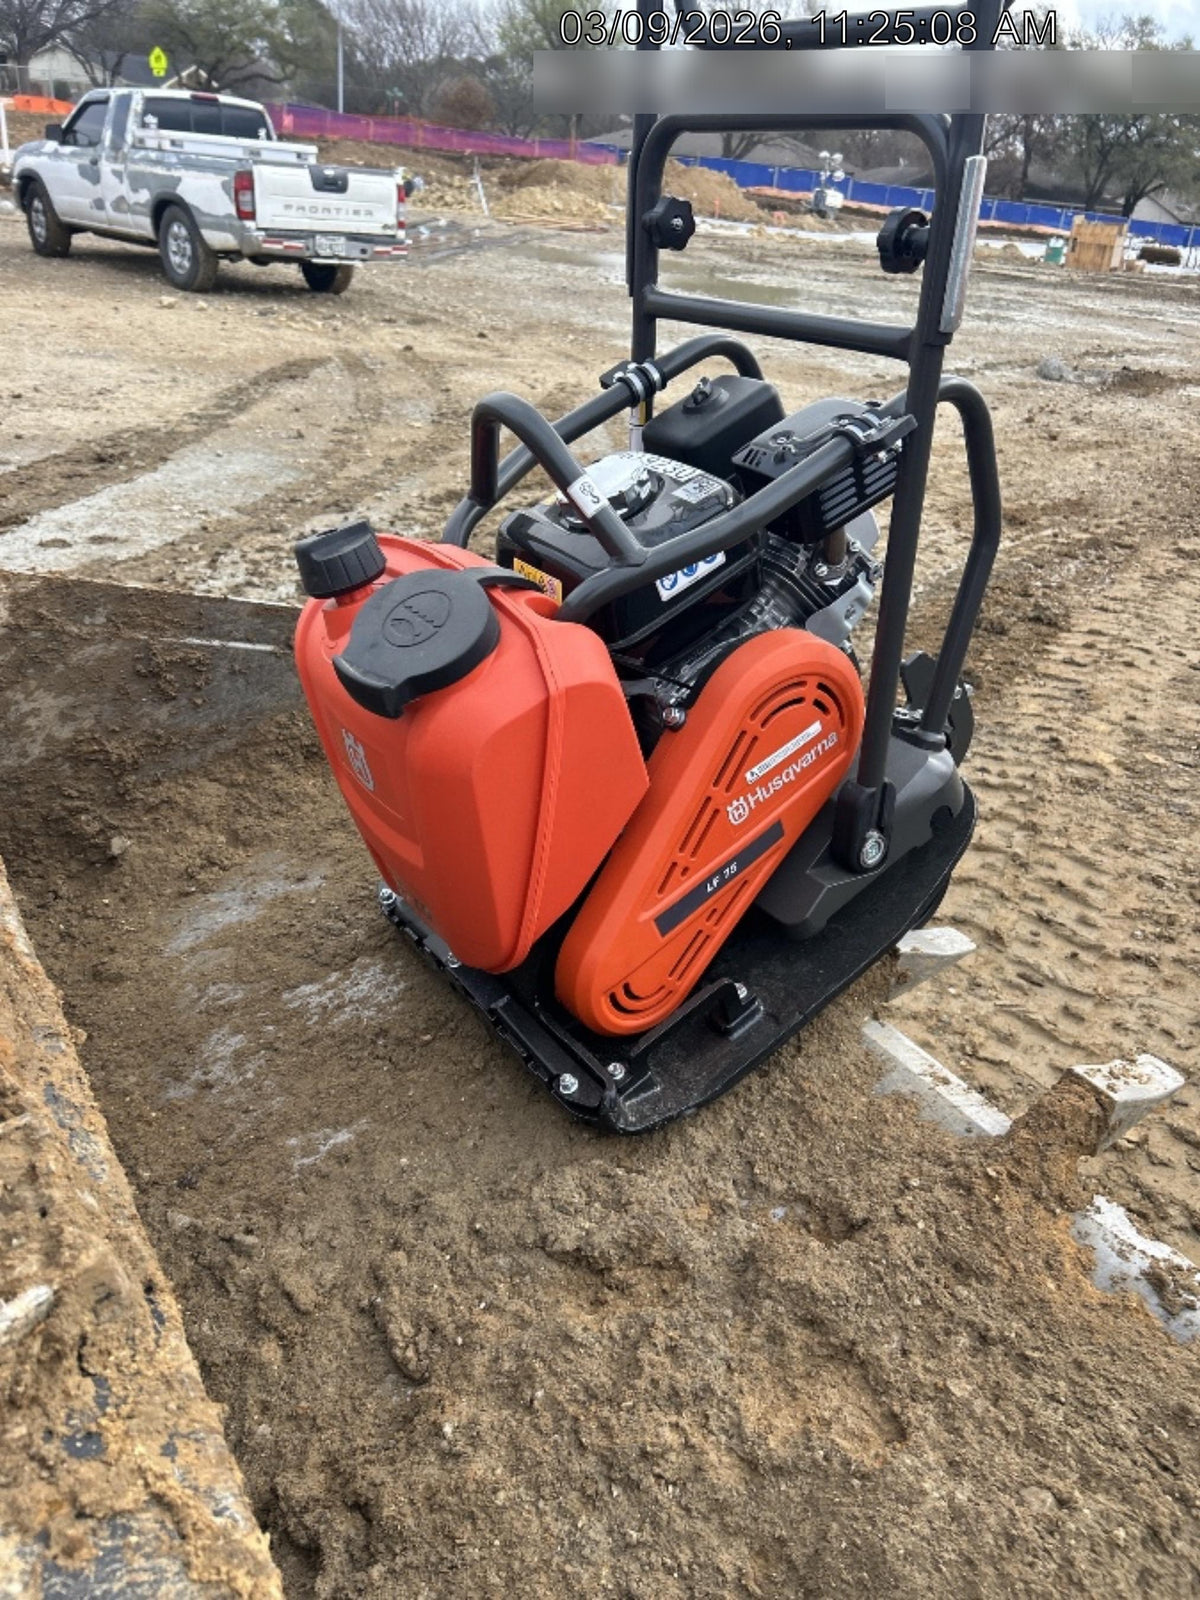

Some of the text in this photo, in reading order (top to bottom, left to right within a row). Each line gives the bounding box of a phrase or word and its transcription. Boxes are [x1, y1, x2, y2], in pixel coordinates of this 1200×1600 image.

[283, 204, 374, 216] FRONTIER
[747, 732, 838, 809] Husqvarna
[706, 861, 738, 893] LF 75
